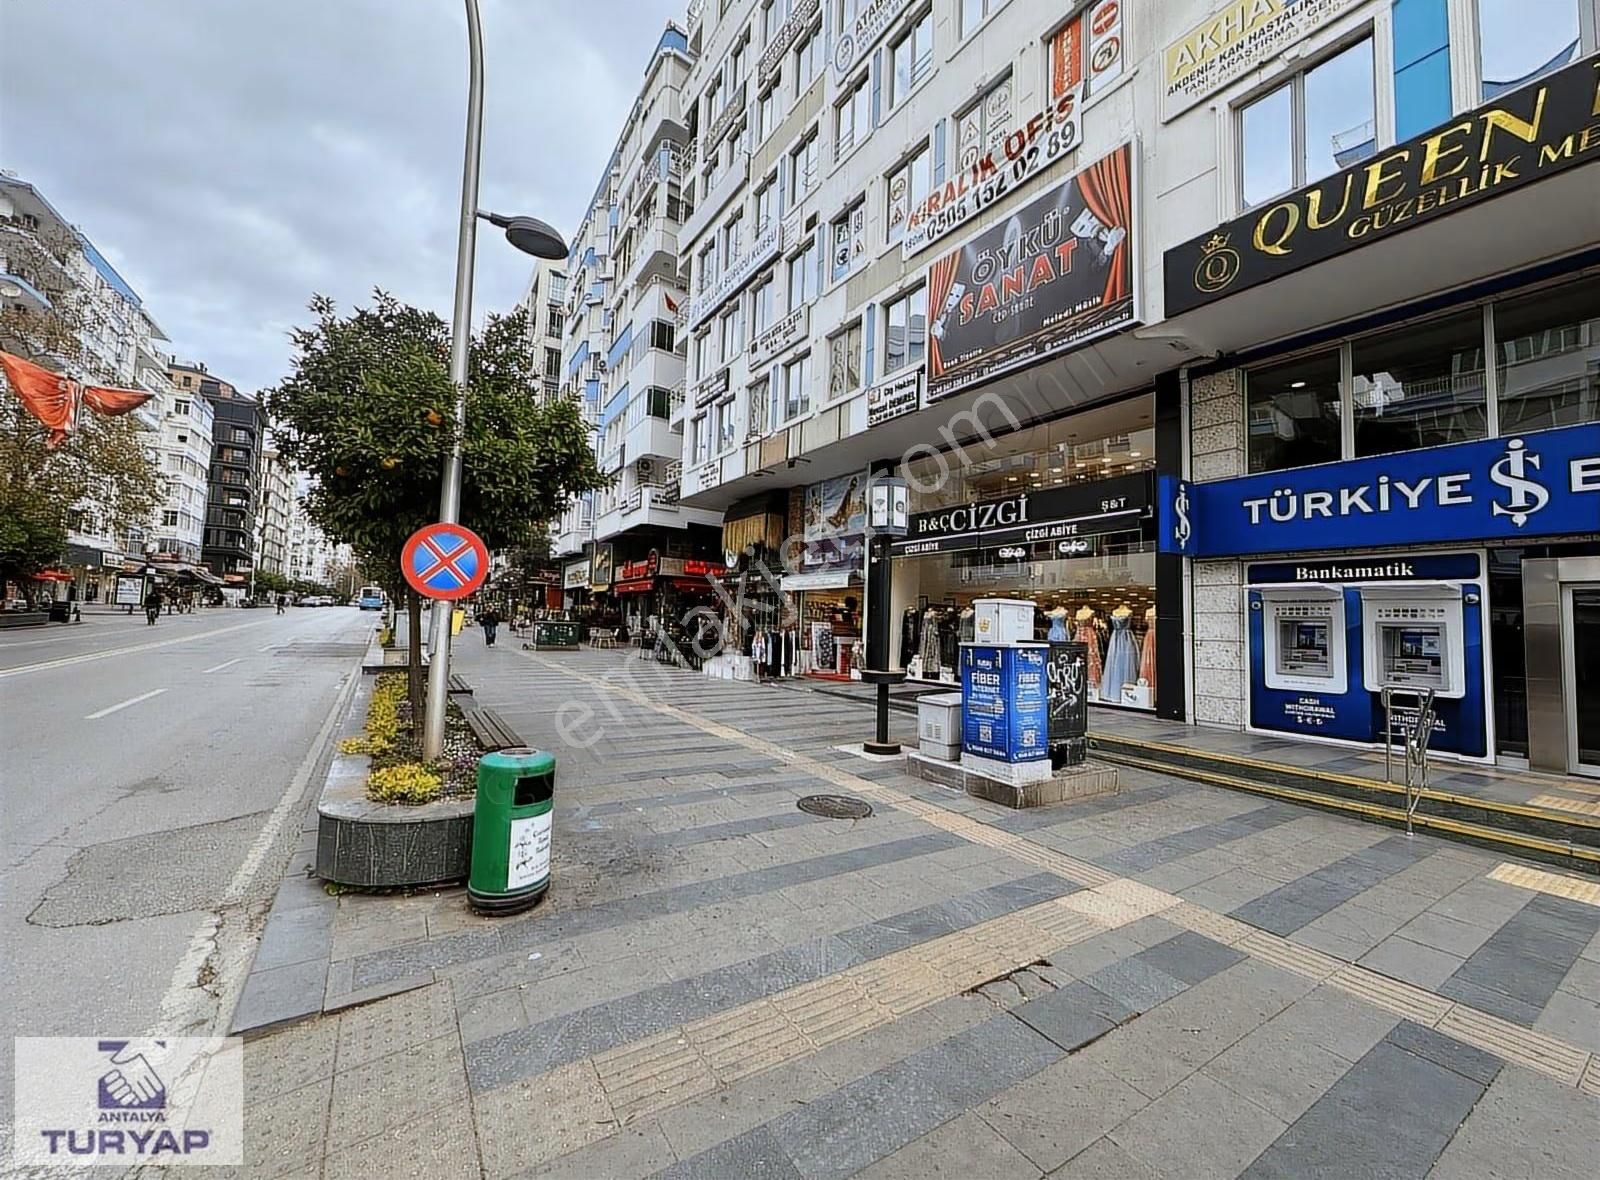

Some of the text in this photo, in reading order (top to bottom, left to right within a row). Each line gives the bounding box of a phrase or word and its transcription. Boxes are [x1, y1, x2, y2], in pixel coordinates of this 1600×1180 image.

[1219, 39, 1245, 63] KAN
[1184, 74, 1209, 95] TANI
[1004, 94, 1076, 162] OFİS
[927, 197, 967, 241] 0505
[972, 176, 1008, 211] 152
[1012, 146, 1041, 182] 02
[1046, 121, 1076, 159] 89
[1251, 86, 1547, 256] QUEEN
[1348, 154, 1521, 240] GÜZELLİK
[971, 206, 1064, 286] ÖYKÜ
[959, 236, 1078, 326] SANAT
[1243, 474, 1473, 525] TÜRKİYE
[1025, 524, 1078, 542] ÇİZGİ ABİYE
[1295, 562, 1415, 581] Bankamatik
[971, 670, 1001, 686] FİBER
